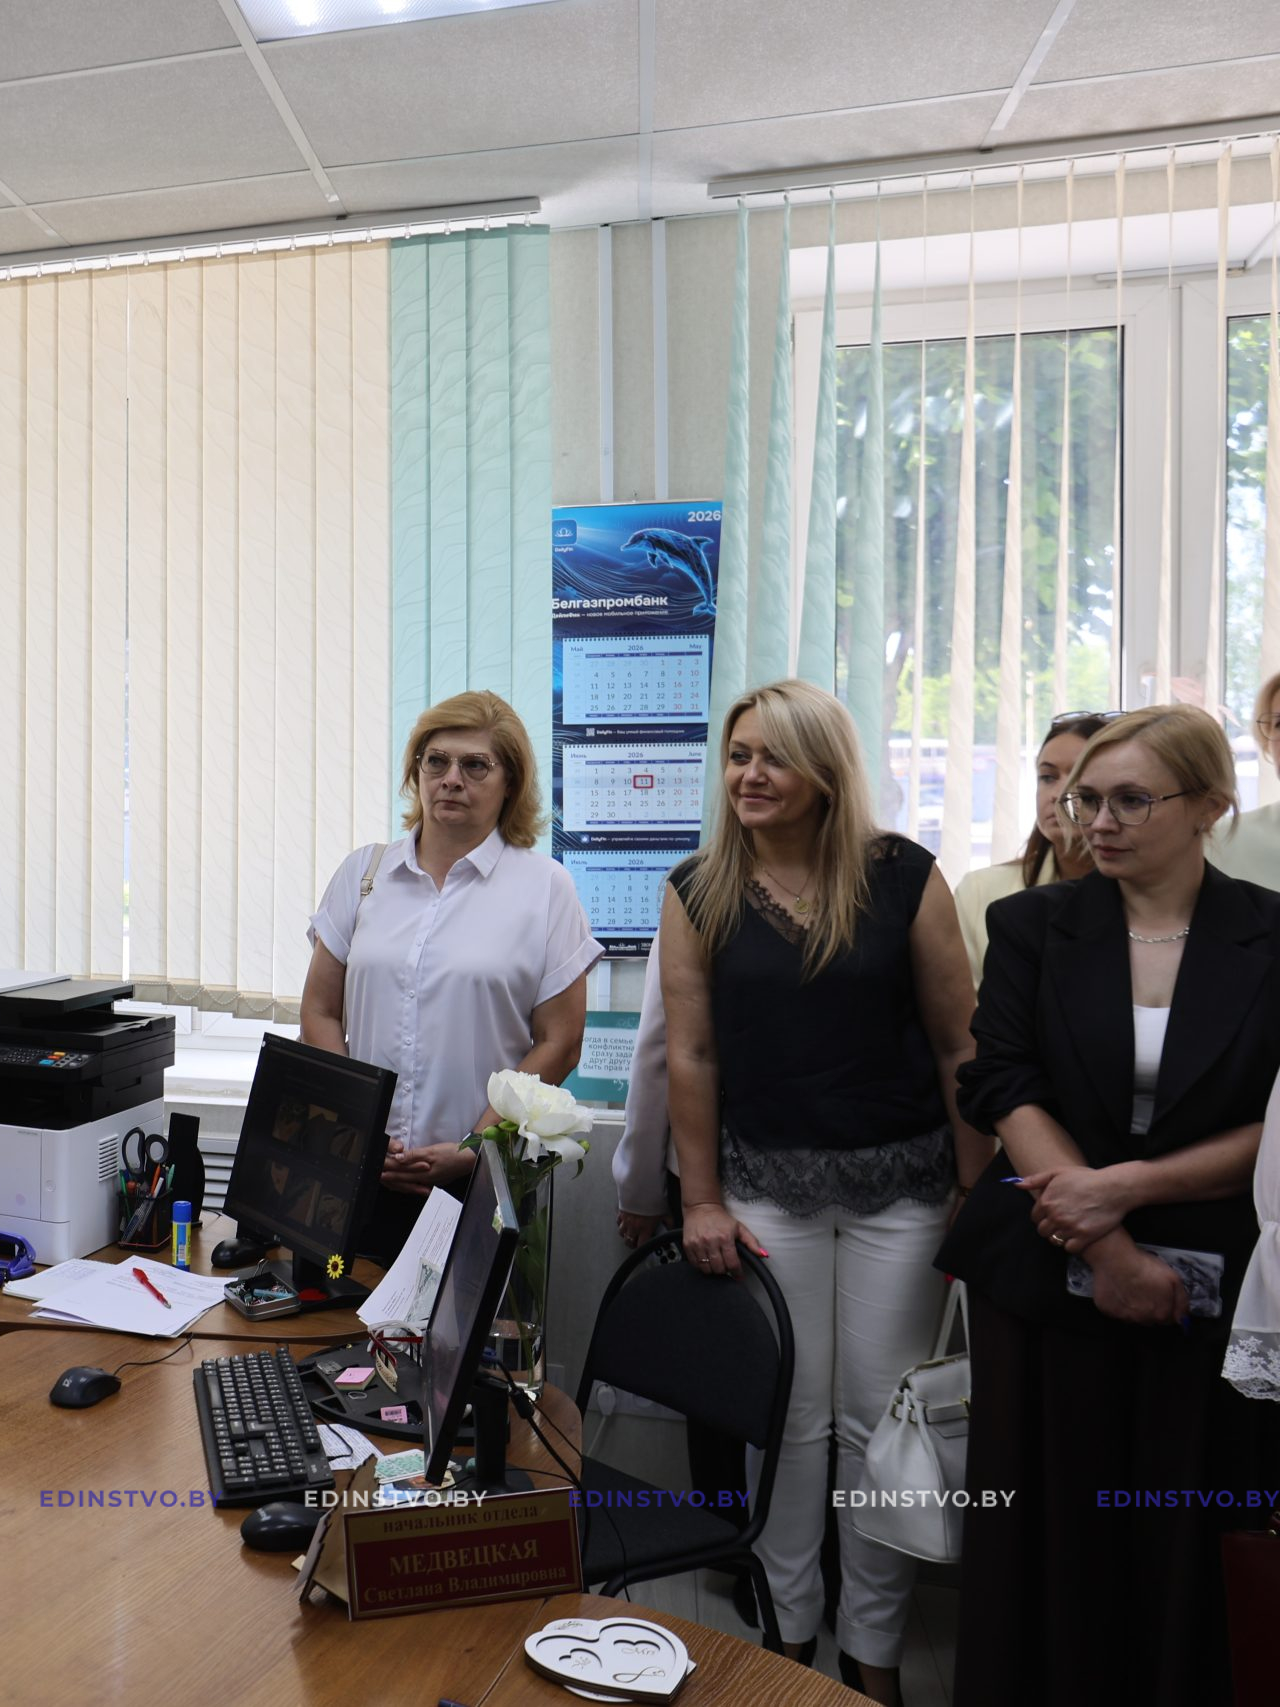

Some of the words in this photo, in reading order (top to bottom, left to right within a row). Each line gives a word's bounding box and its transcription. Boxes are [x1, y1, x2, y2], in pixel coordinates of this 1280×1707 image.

[687, 510, 721, 522] 2026
[552, 595, 668, 610] Белгазпромбанк
[383, 1512, 478, 1533] начальник
[483, 1505, 538, 1522] отдела
[390, 1539, 539, 1577] МЕДВЕЦКАЯ
[363, 1582, 443, 1604] Светлана
[448, 1567, 567, 1593] Владимировна
